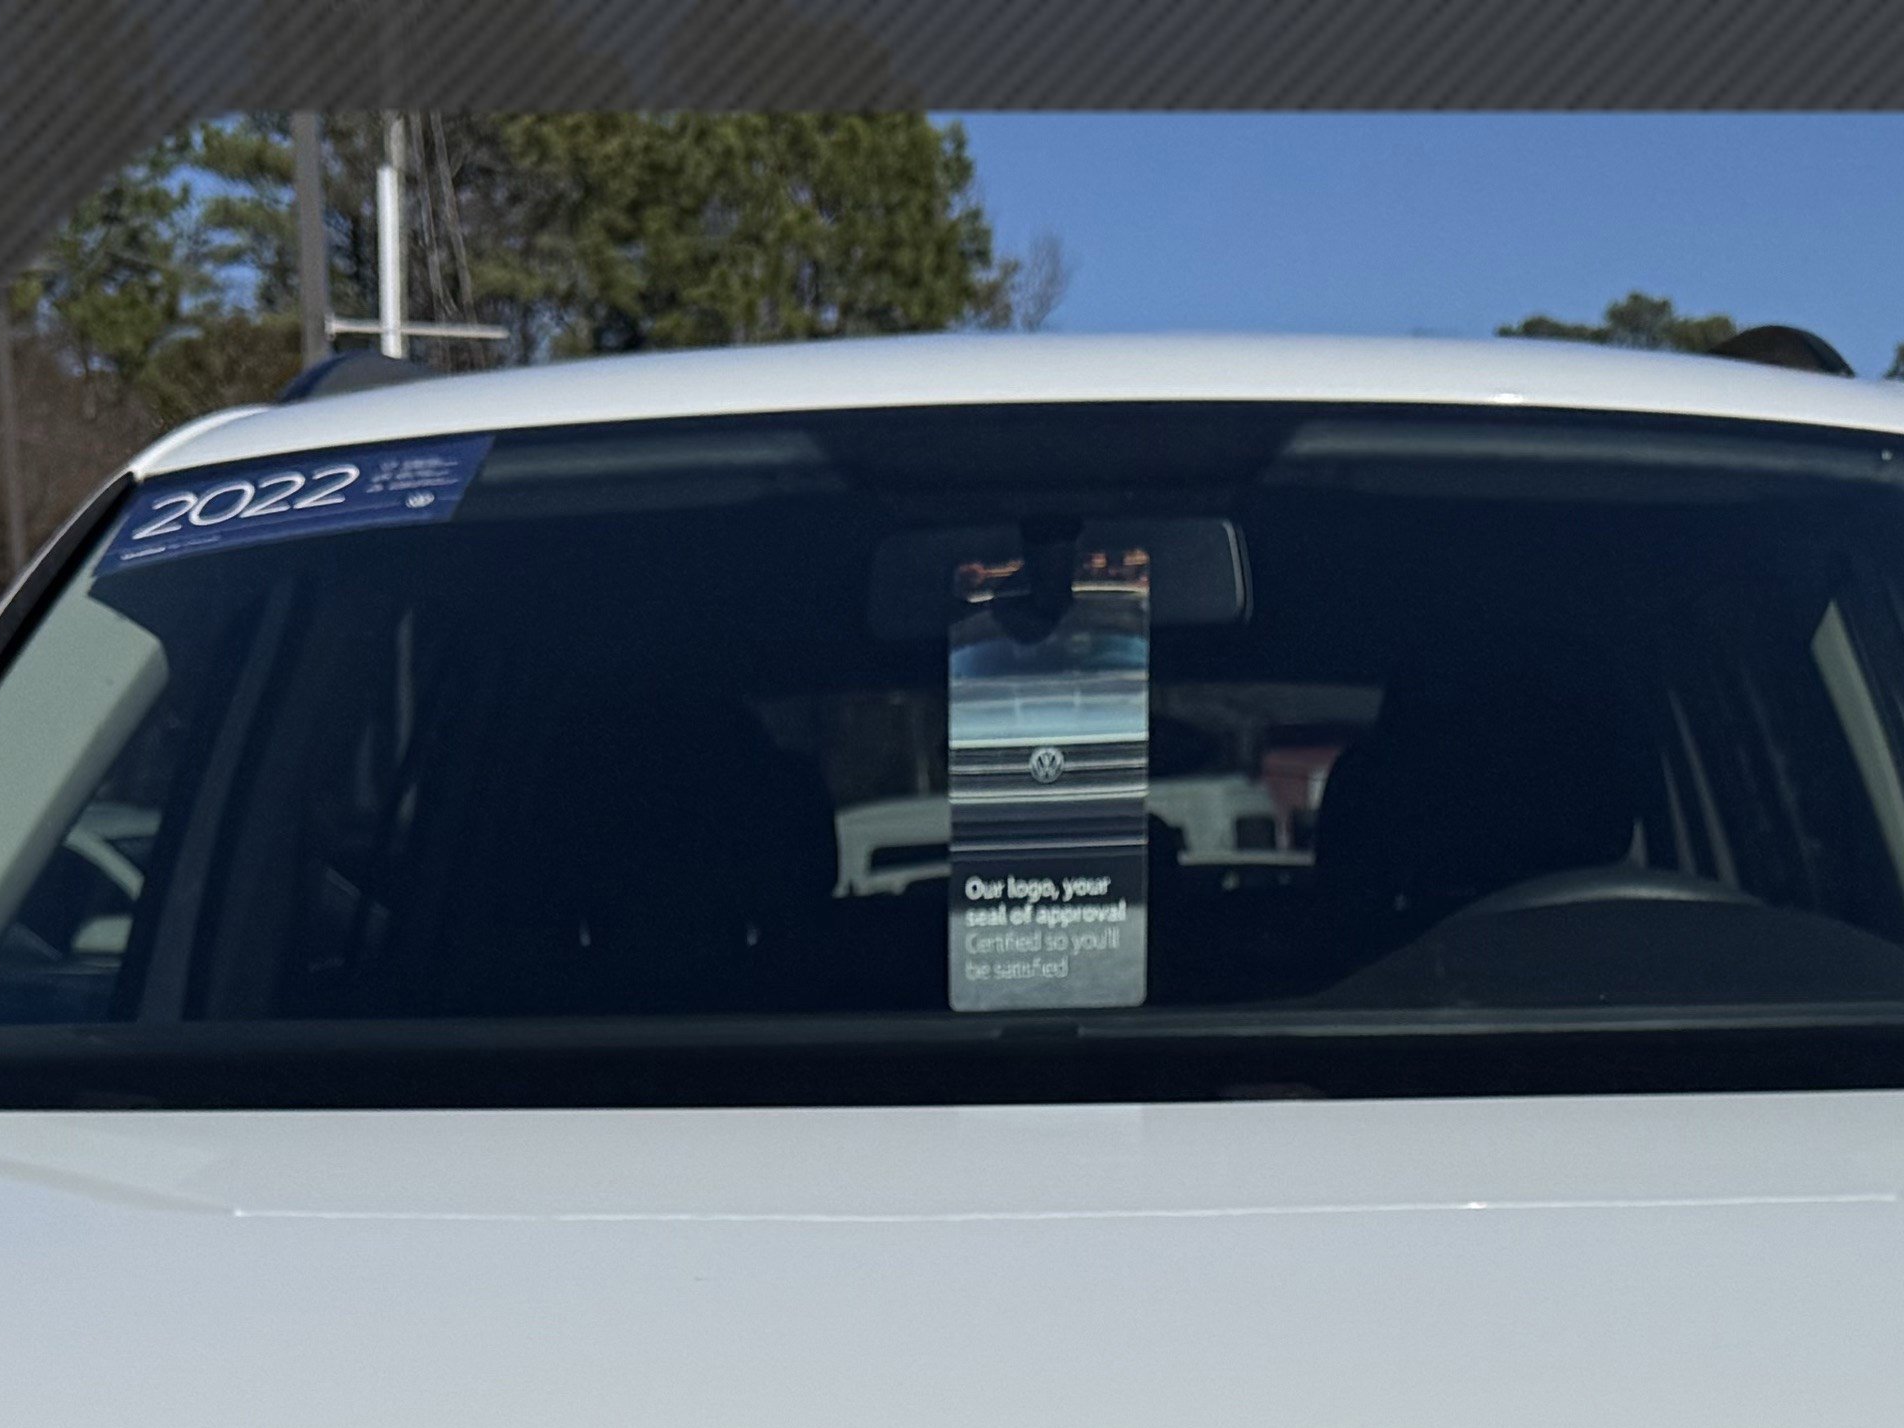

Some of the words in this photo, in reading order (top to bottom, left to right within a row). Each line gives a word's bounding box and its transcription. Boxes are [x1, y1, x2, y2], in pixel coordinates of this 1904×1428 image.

[131, 463, 360, 541] 2022
[965, 876, 1005, 900] Our
[1007, 874, 1059, 903] logo,
[1062, 876, 1111, 902] your
[966, 901, 1007, 927] seal
[1010, 902, 1032, 925] of
[1036, 897, 1126, 928] approval
[965, 929, 1042, 954] Certified
[1046, 931, 1069, 951] so
[965, 959, 991, 980] be
